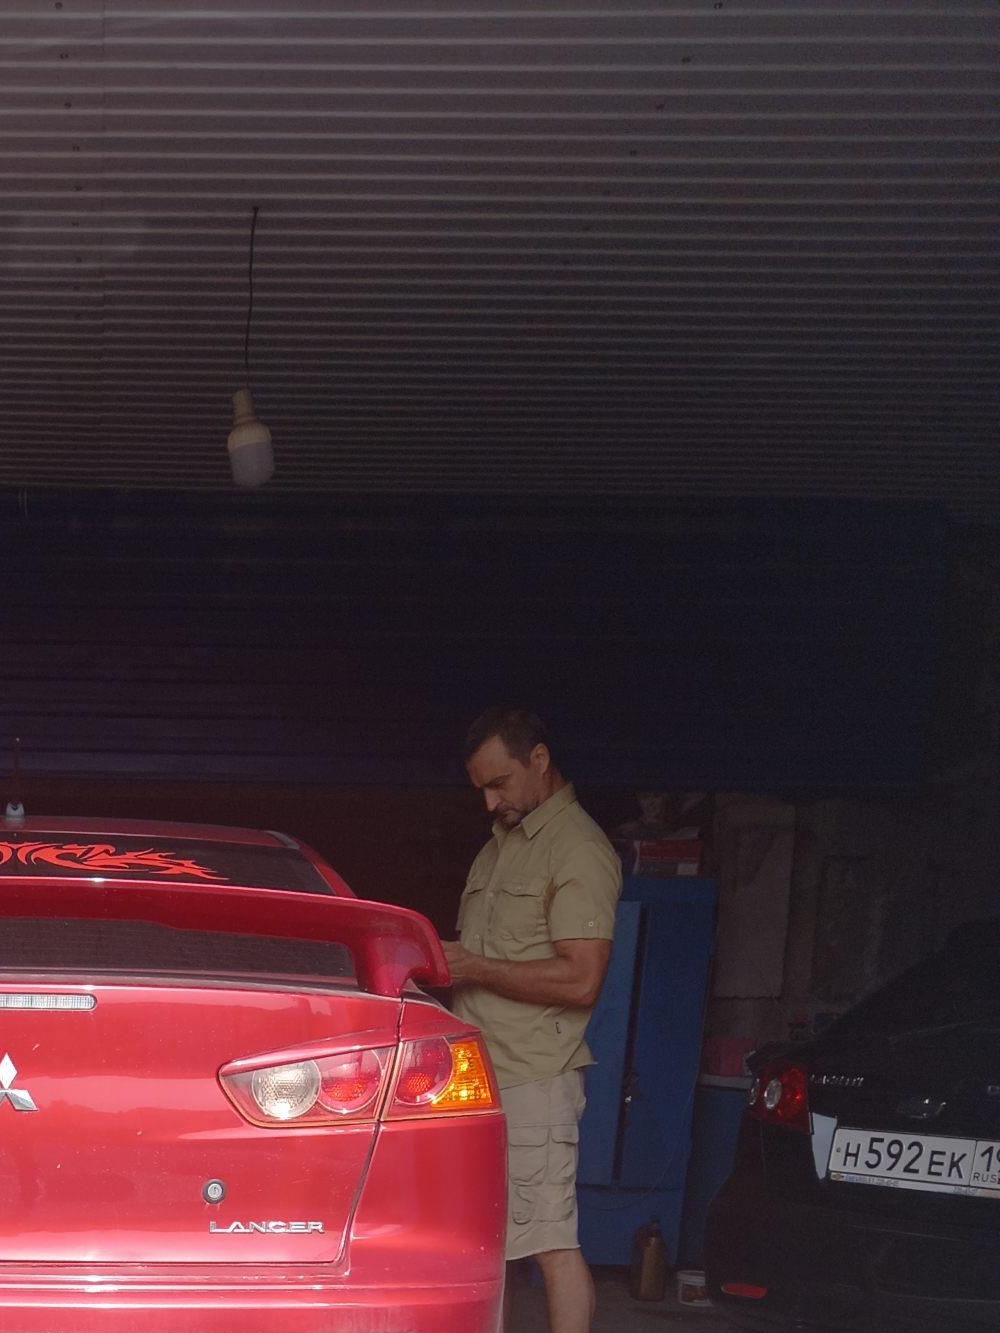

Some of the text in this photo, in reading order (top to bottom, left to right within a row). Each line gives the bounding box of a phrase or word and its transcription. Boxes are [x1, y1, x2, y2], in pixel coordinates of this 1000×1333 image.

[843, 1137, 968, 1179] Н592ЕК
[973, 1172, 997, 1184] RUS
[209, 1220, 325, 1234] LANCER
